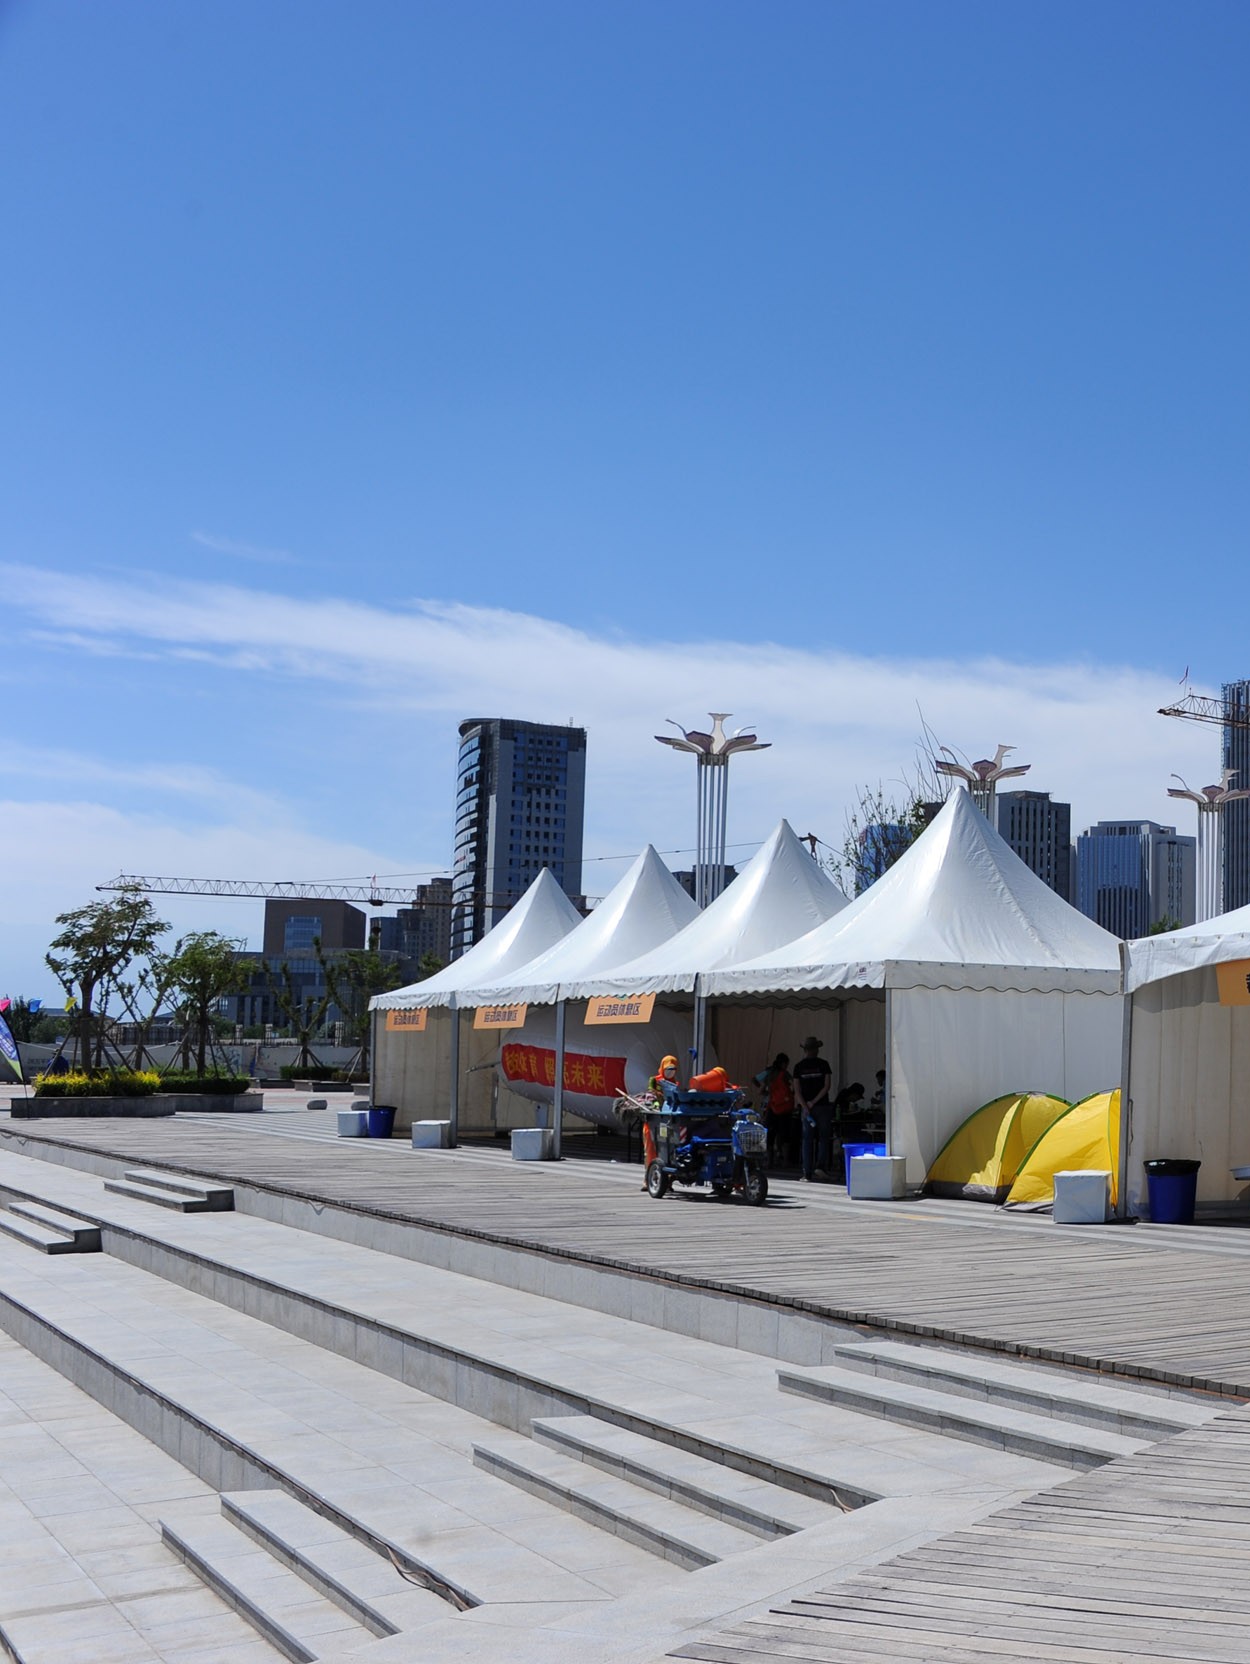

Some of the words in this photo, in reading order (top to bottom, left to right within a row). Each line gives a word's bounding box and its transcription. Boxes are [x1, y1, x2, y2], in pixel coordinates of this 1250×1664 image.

[597, 1002, 642, 1017] 运动员休息区
